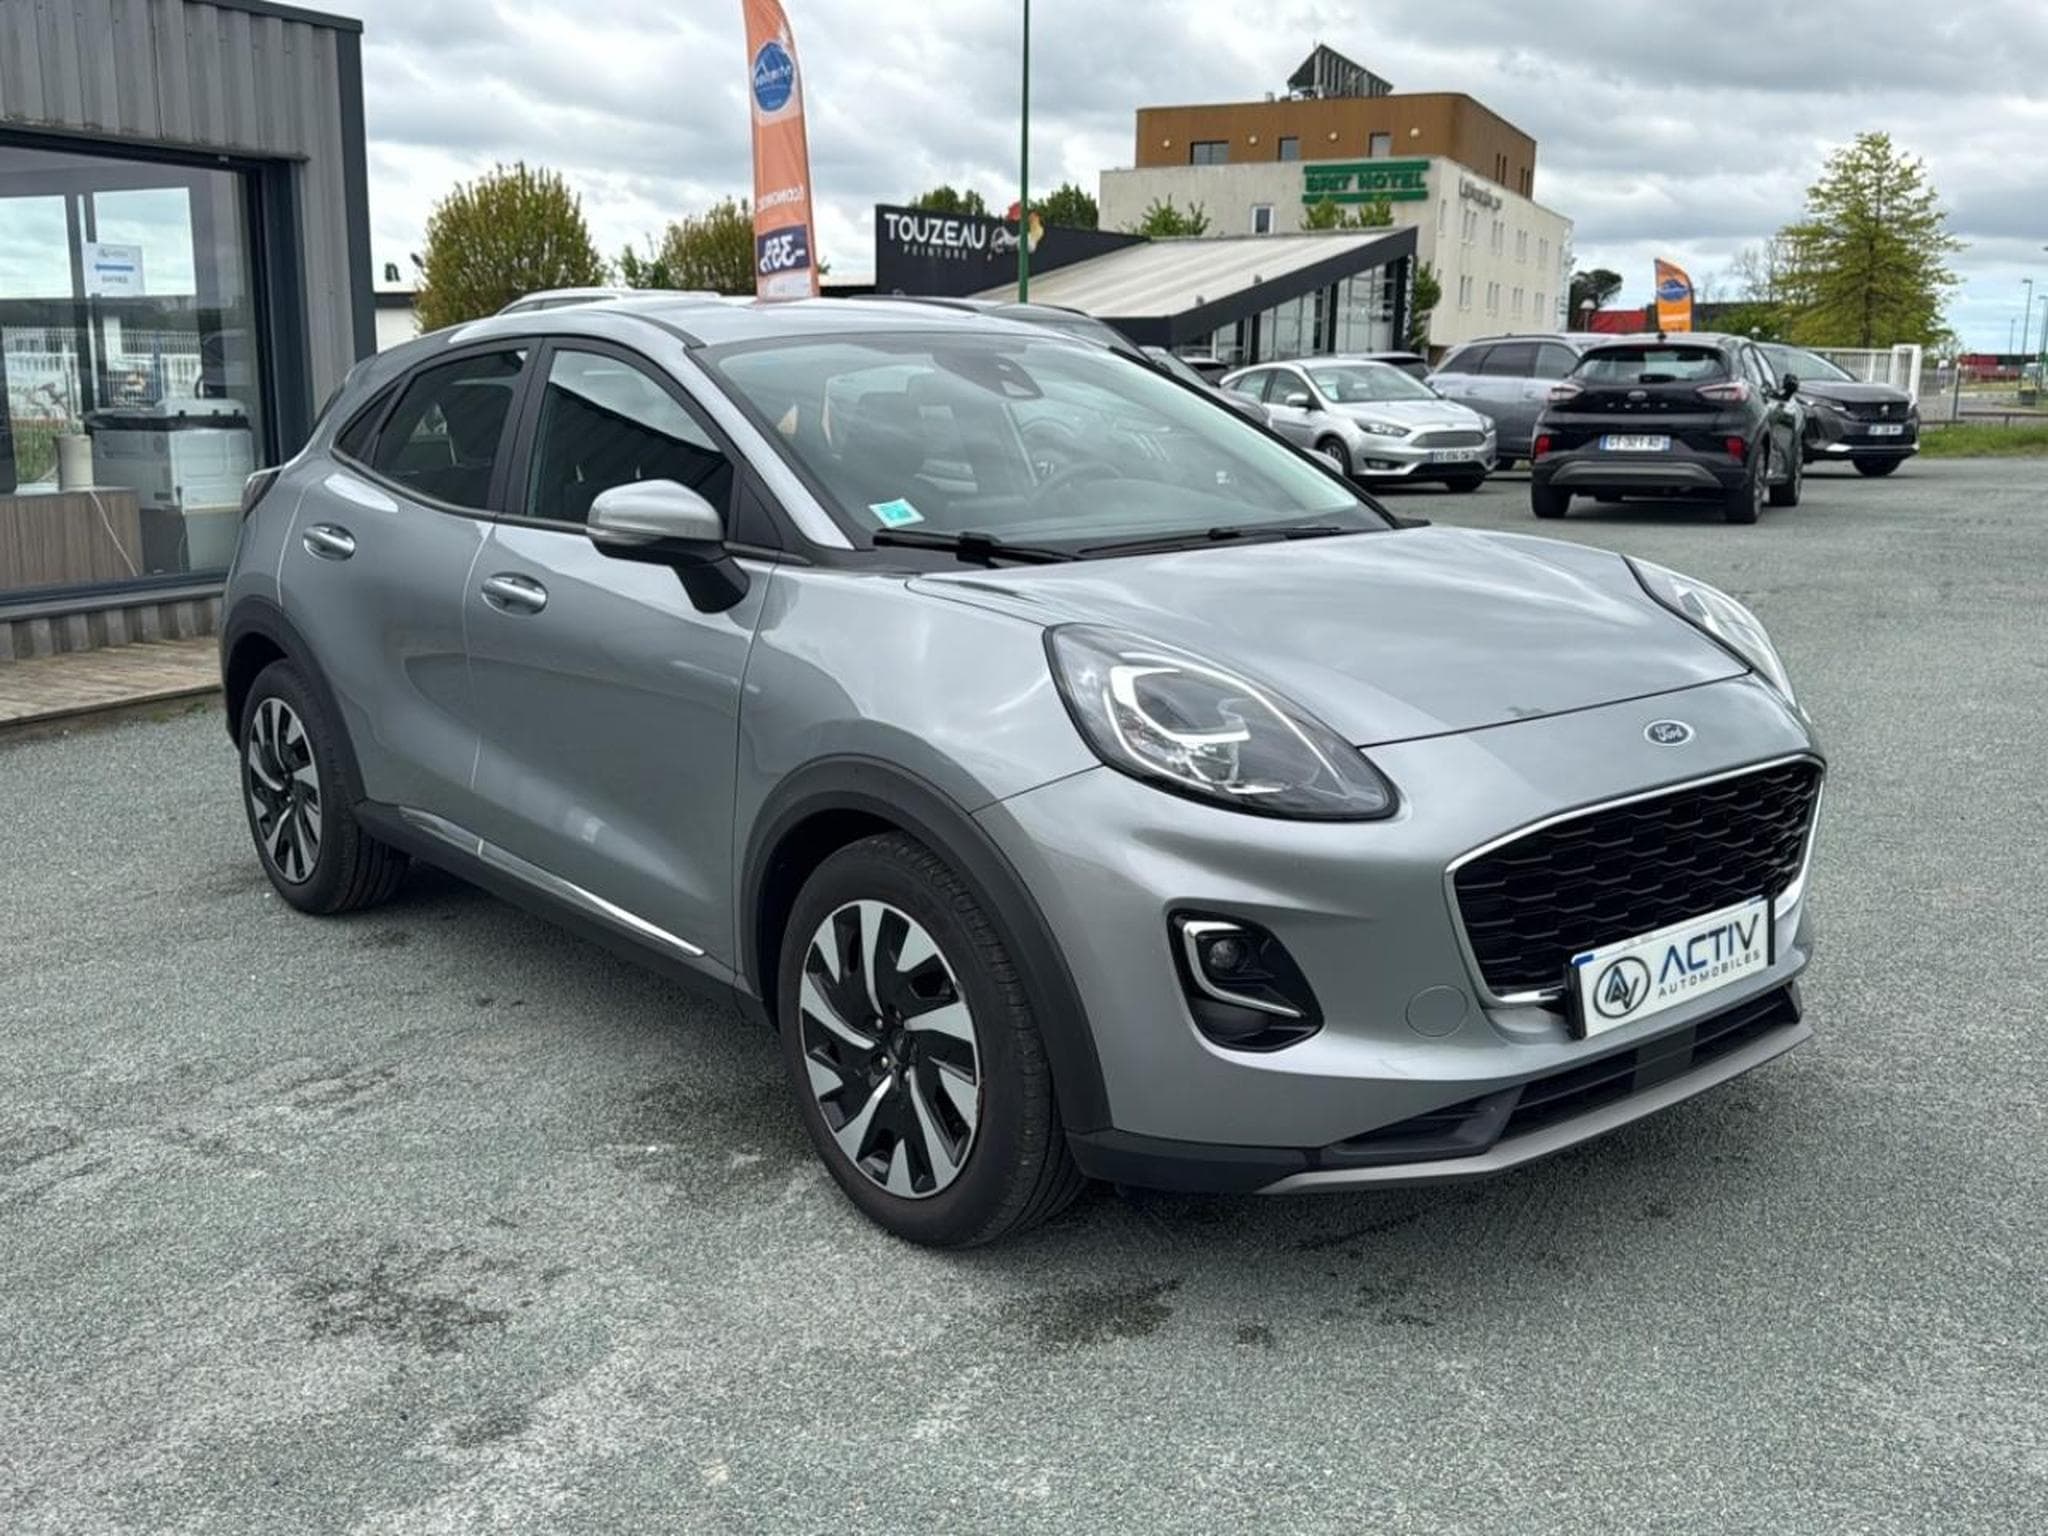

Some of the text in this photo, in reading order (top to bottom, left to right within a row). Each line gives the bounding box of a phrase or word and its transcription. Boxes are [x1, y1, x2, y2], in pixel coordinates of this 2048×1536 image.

[884, 213, 987, 250] TOUZEAU
[1657, 948, 1761, 999] AUTOMOBILES
[1658, 913, 1760, 984] ACTIV
